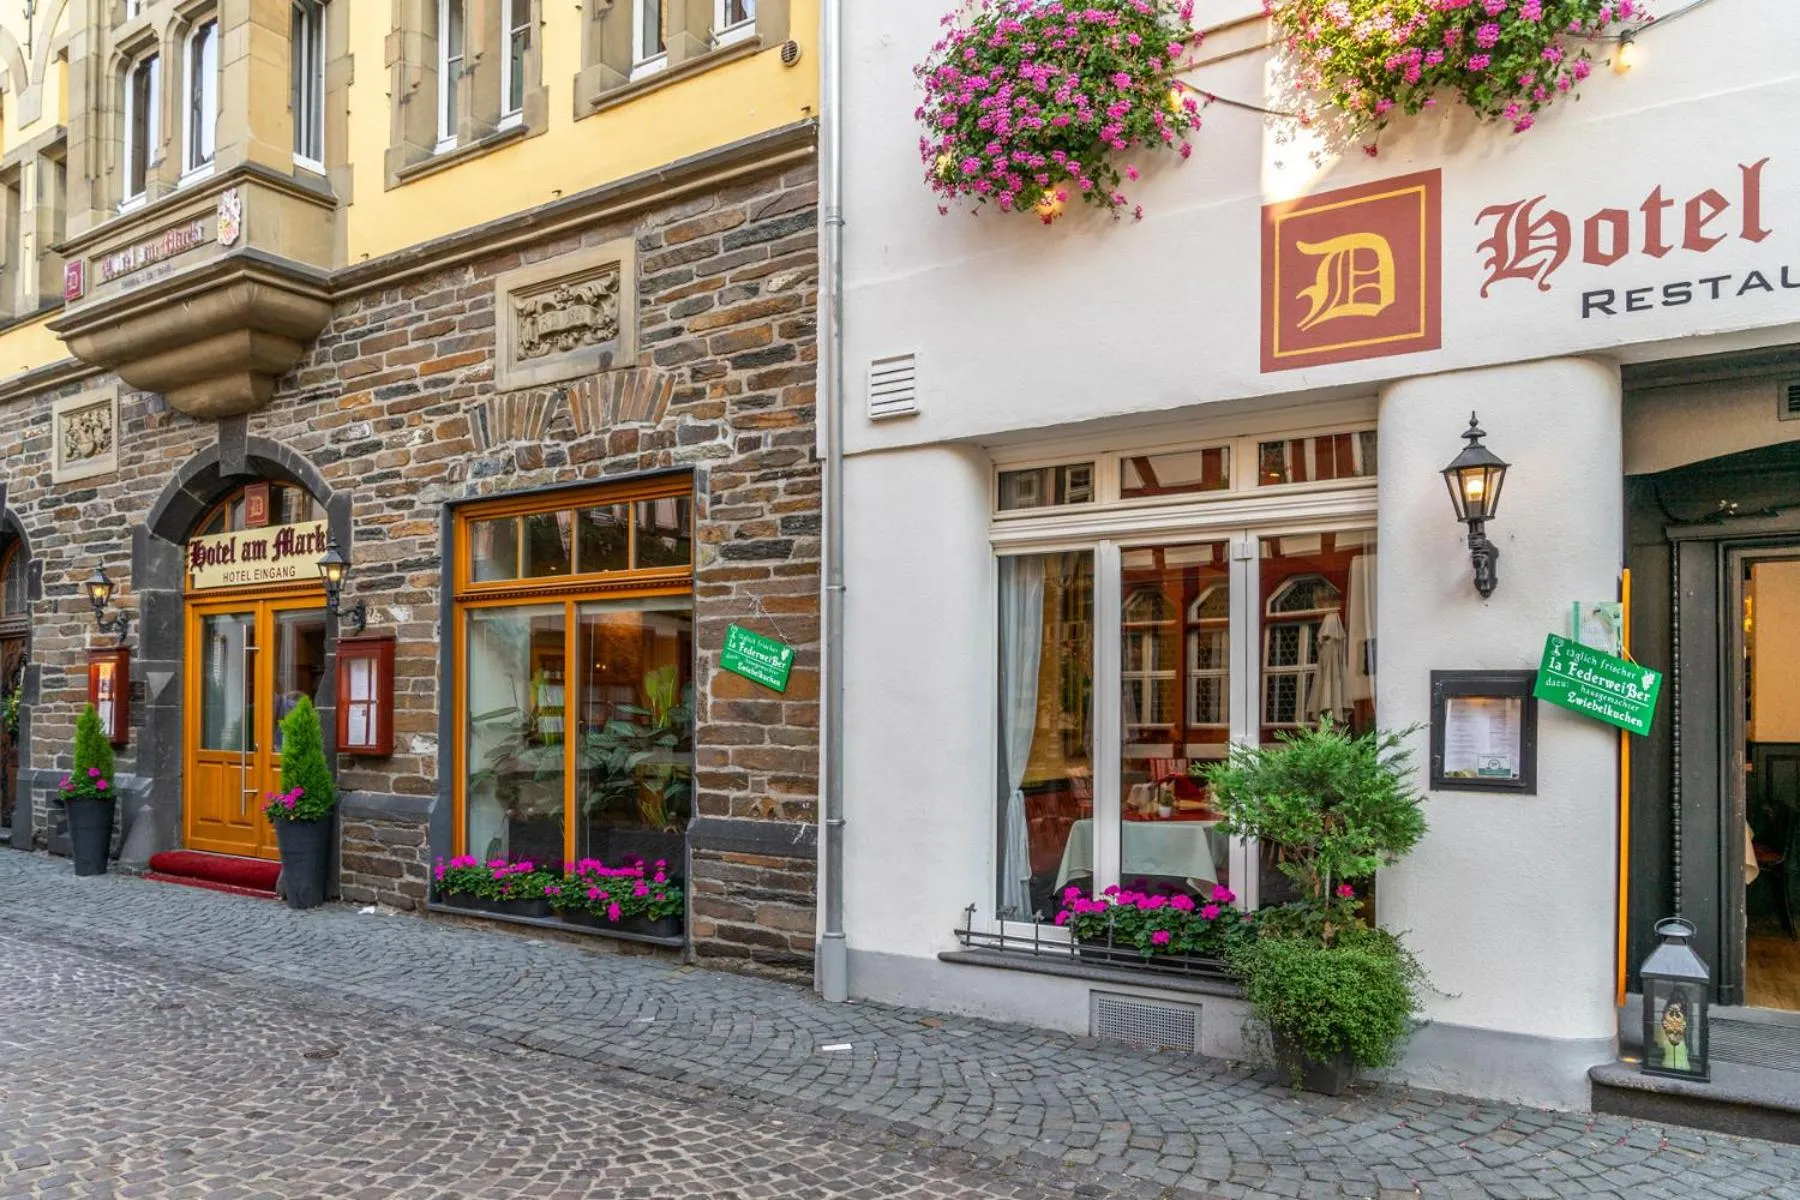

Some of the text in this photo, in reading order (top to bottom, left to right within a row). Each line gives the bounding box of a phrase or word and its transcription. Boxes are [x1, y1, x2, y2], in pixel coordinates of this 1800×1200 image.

[1474, 156, 1773, 298] Hotel
[1296, 232, 1395, 331] D
[188, 523, 328, 573] Hotel am Mark
[223, 566, 296, 583] HOTEL EINGANG
[1566, 648, 1637, 680] täglich frischer
[1567, 691, 1643, 728] Zwiebelkuchen
